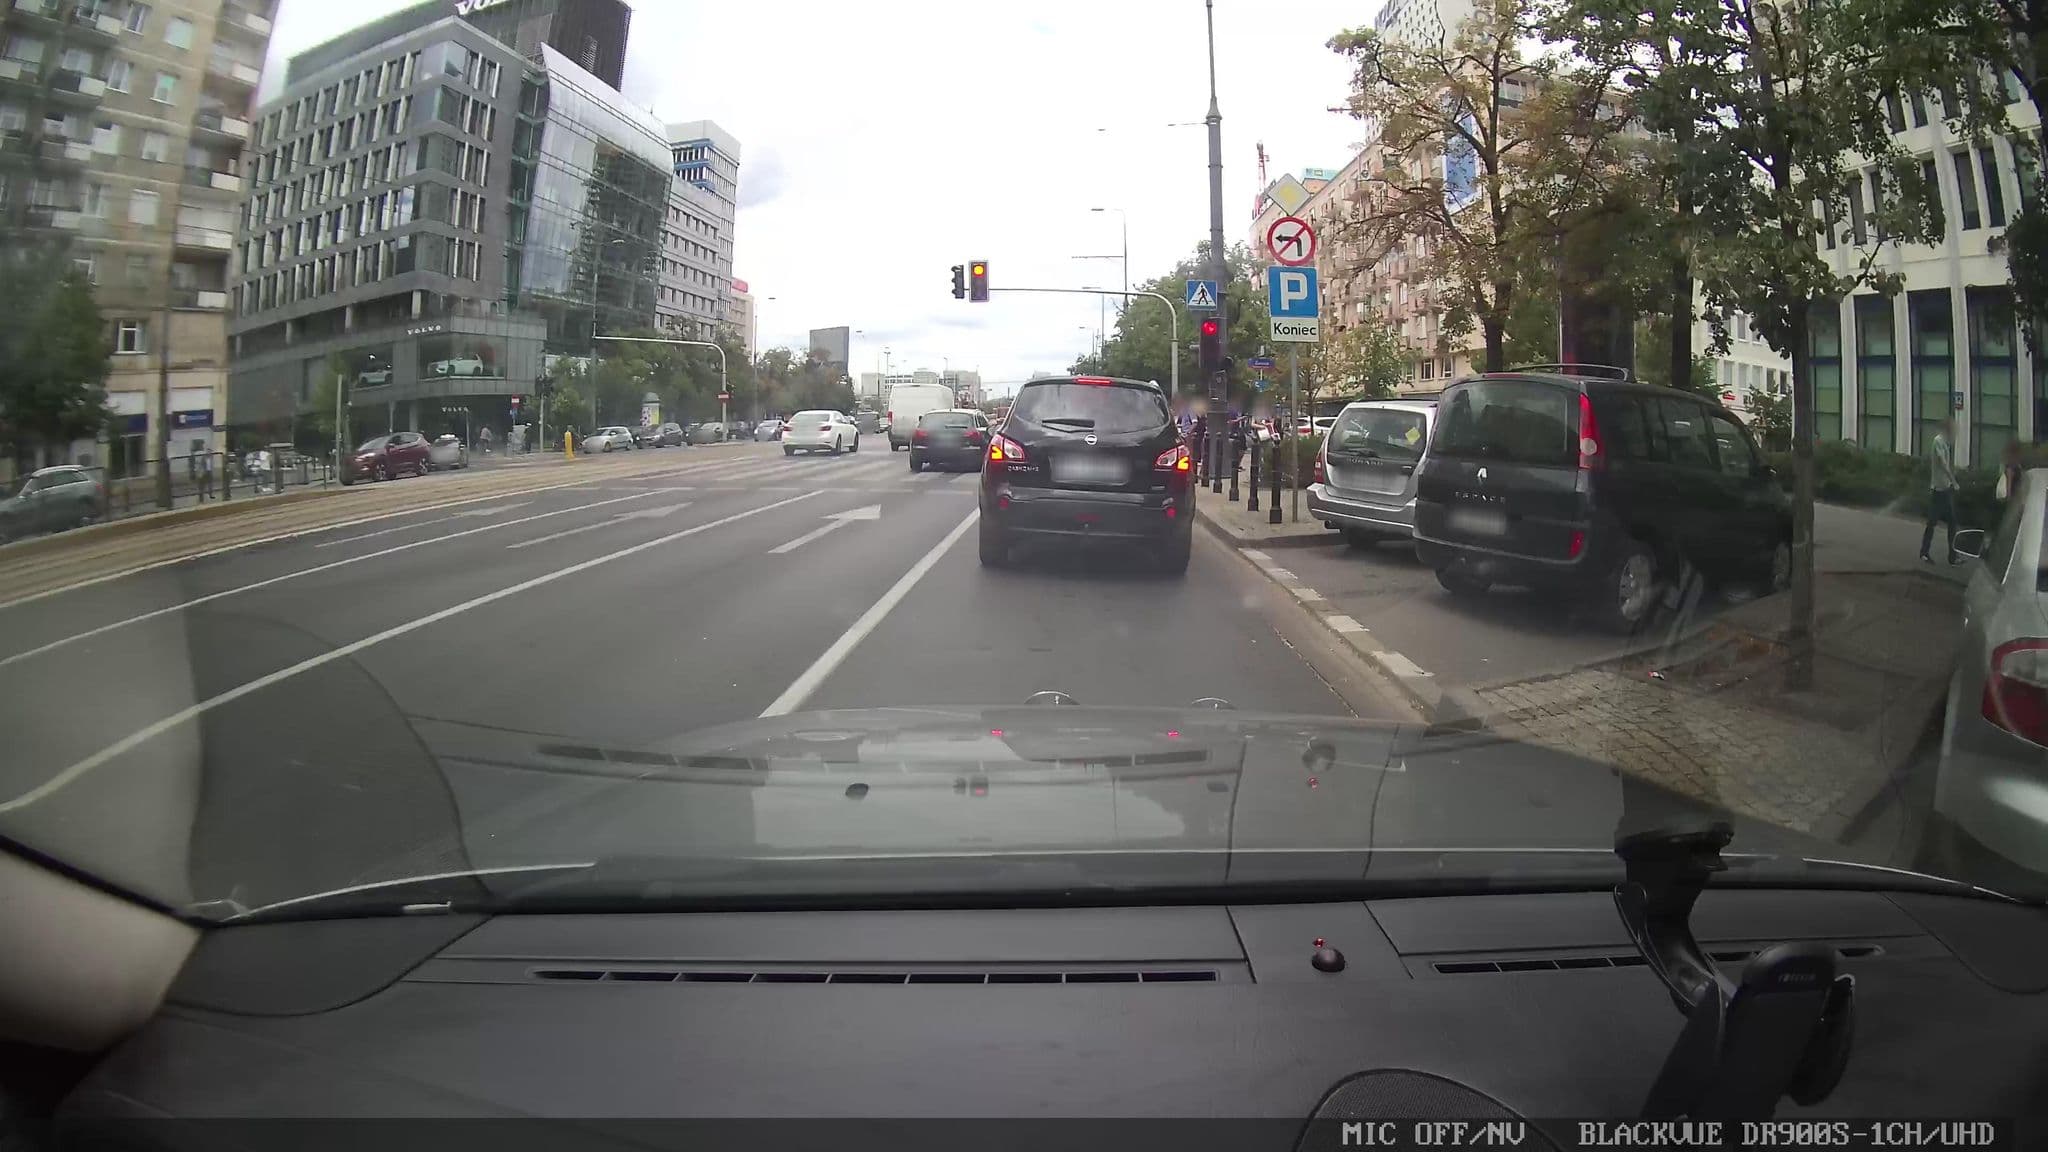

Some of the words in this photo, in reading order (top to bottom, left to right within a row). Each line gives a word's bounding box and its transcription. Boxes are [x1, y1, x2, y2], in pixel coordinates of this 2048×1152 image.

[1280, 272, 1307, 310] P
[407, 325, 441, 335] VOLVO
[1274, 323, 1317, 336] Koniec
